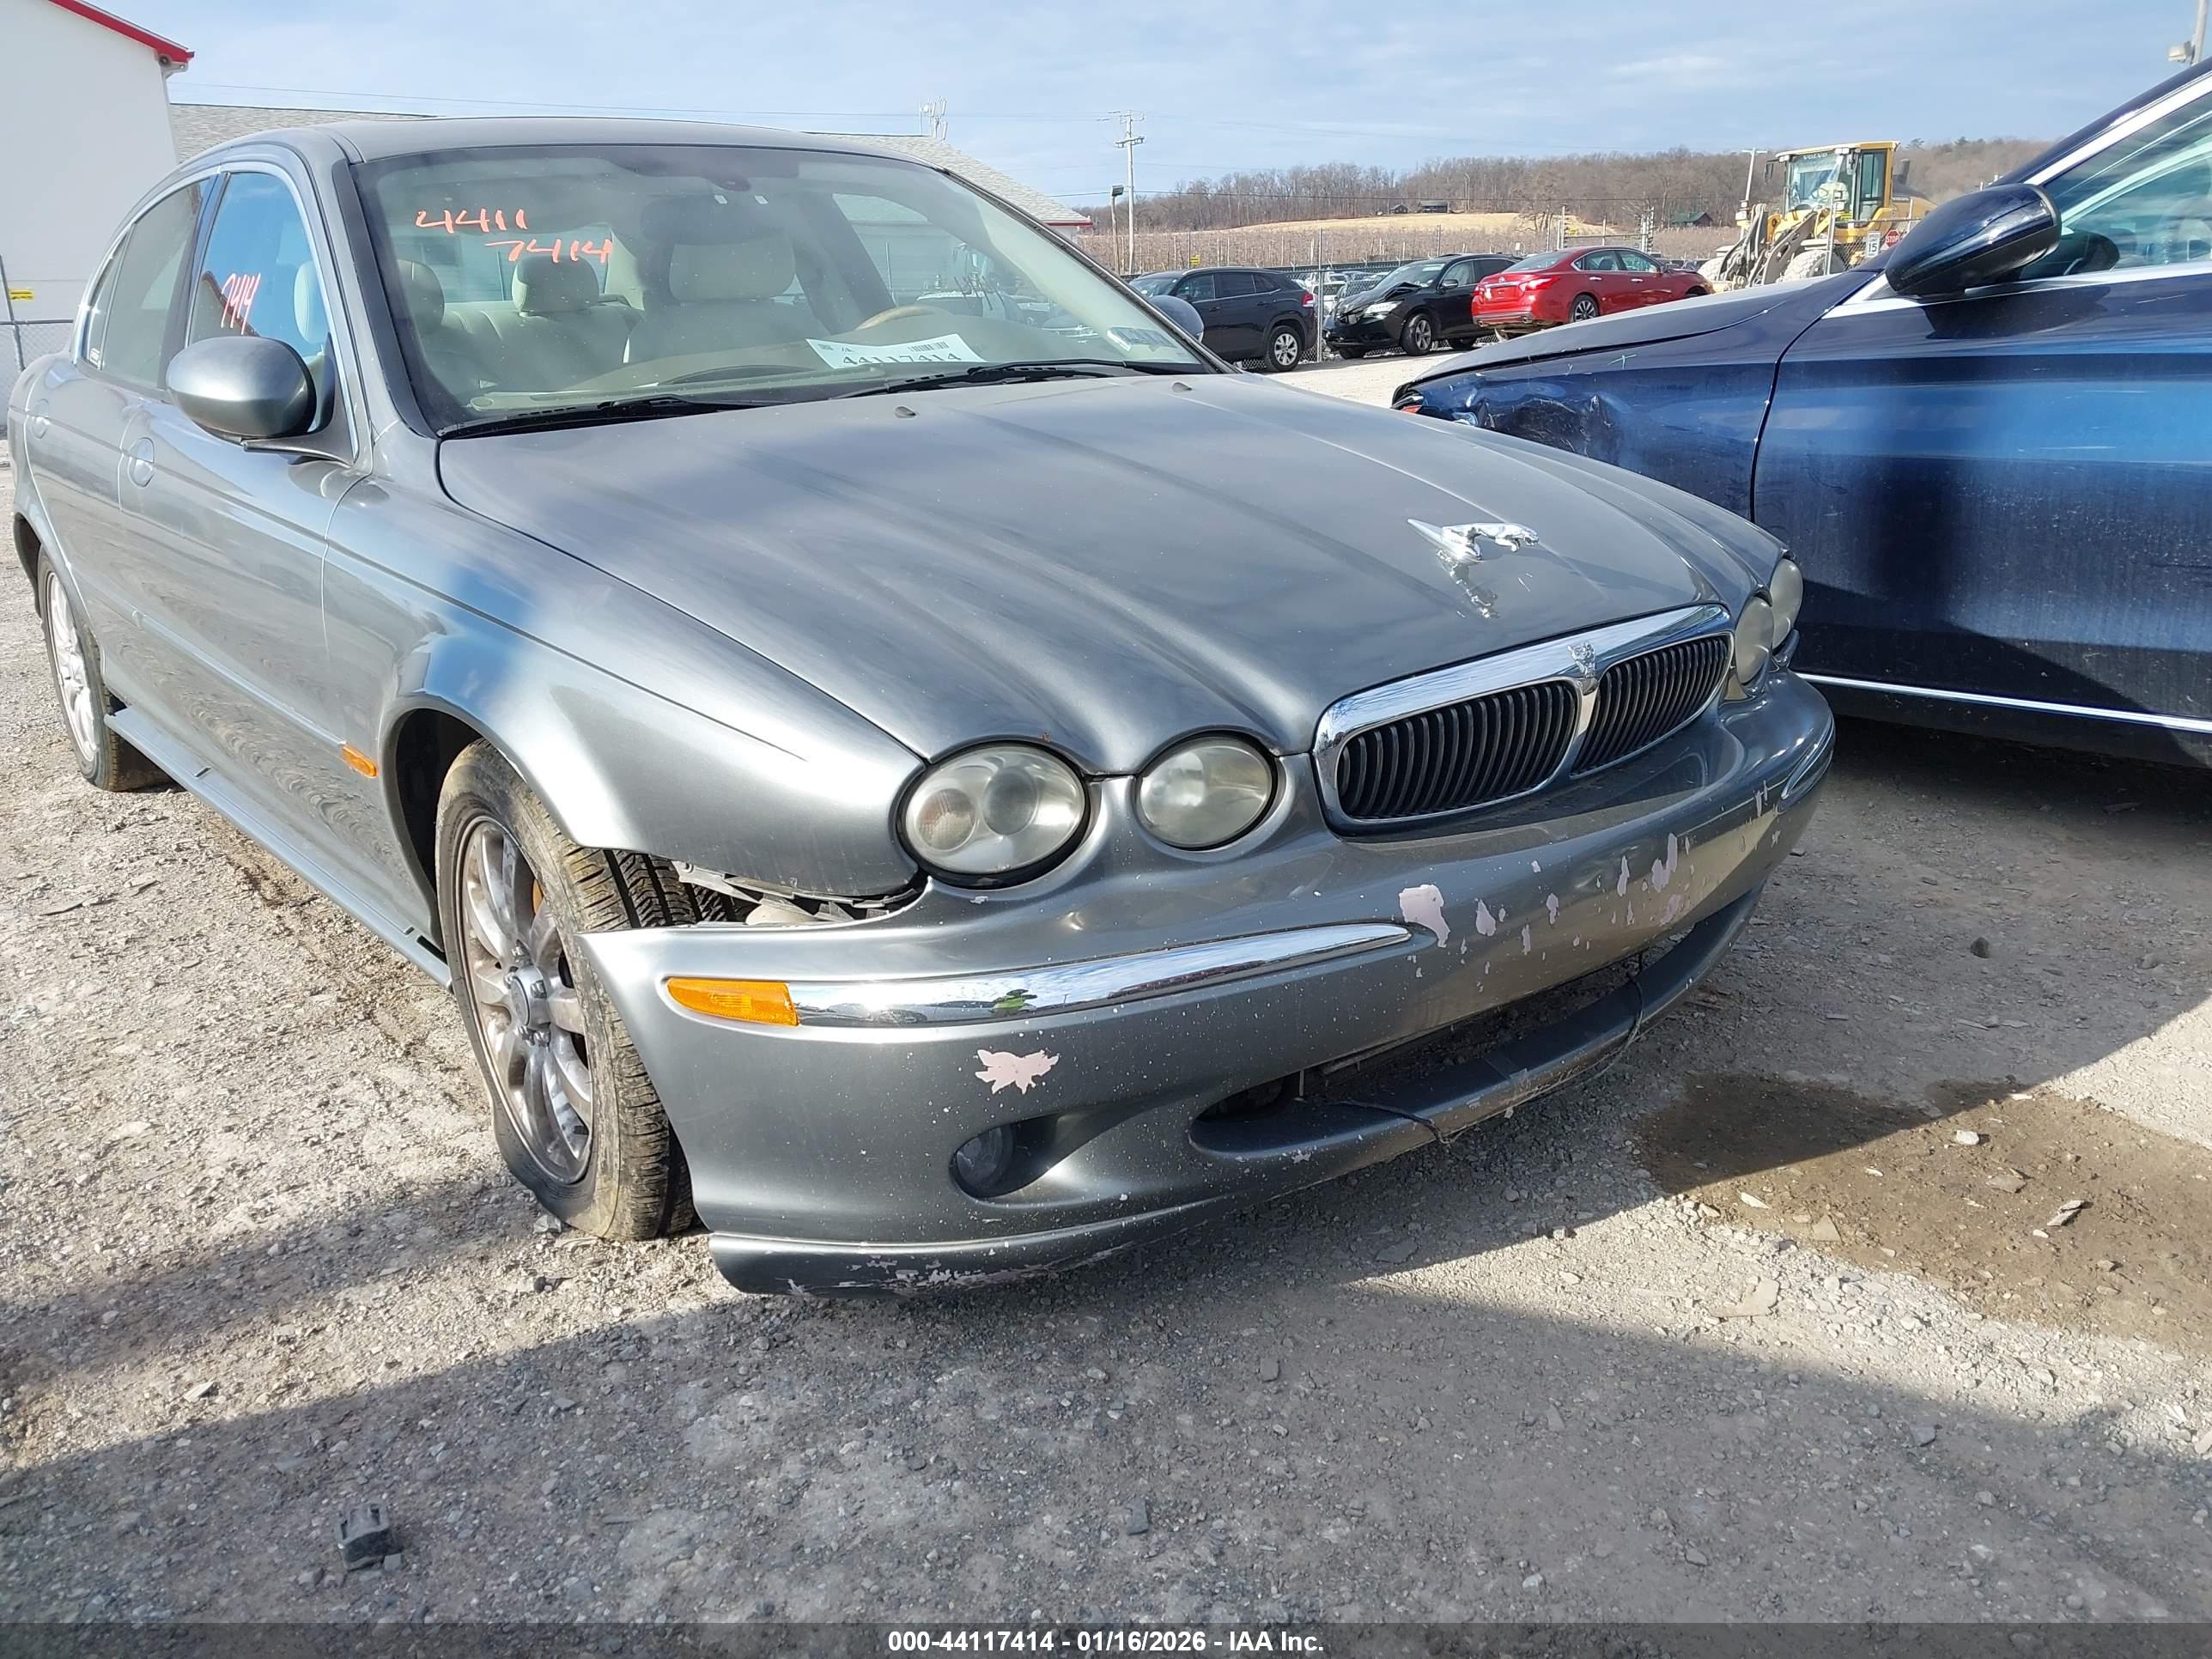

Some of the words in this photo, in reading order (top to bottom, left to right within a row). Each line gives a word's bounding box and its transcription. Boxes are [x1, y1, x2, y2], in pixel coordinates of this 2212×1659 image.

[1803, 152, 1828, 161] VOLVO
[416, 208, 528, 234] 4411
[1886, 235, 1899, 244] STOP
[483, 238, 613, 264] 7414
[1868, 243, 1878, 253] 15
